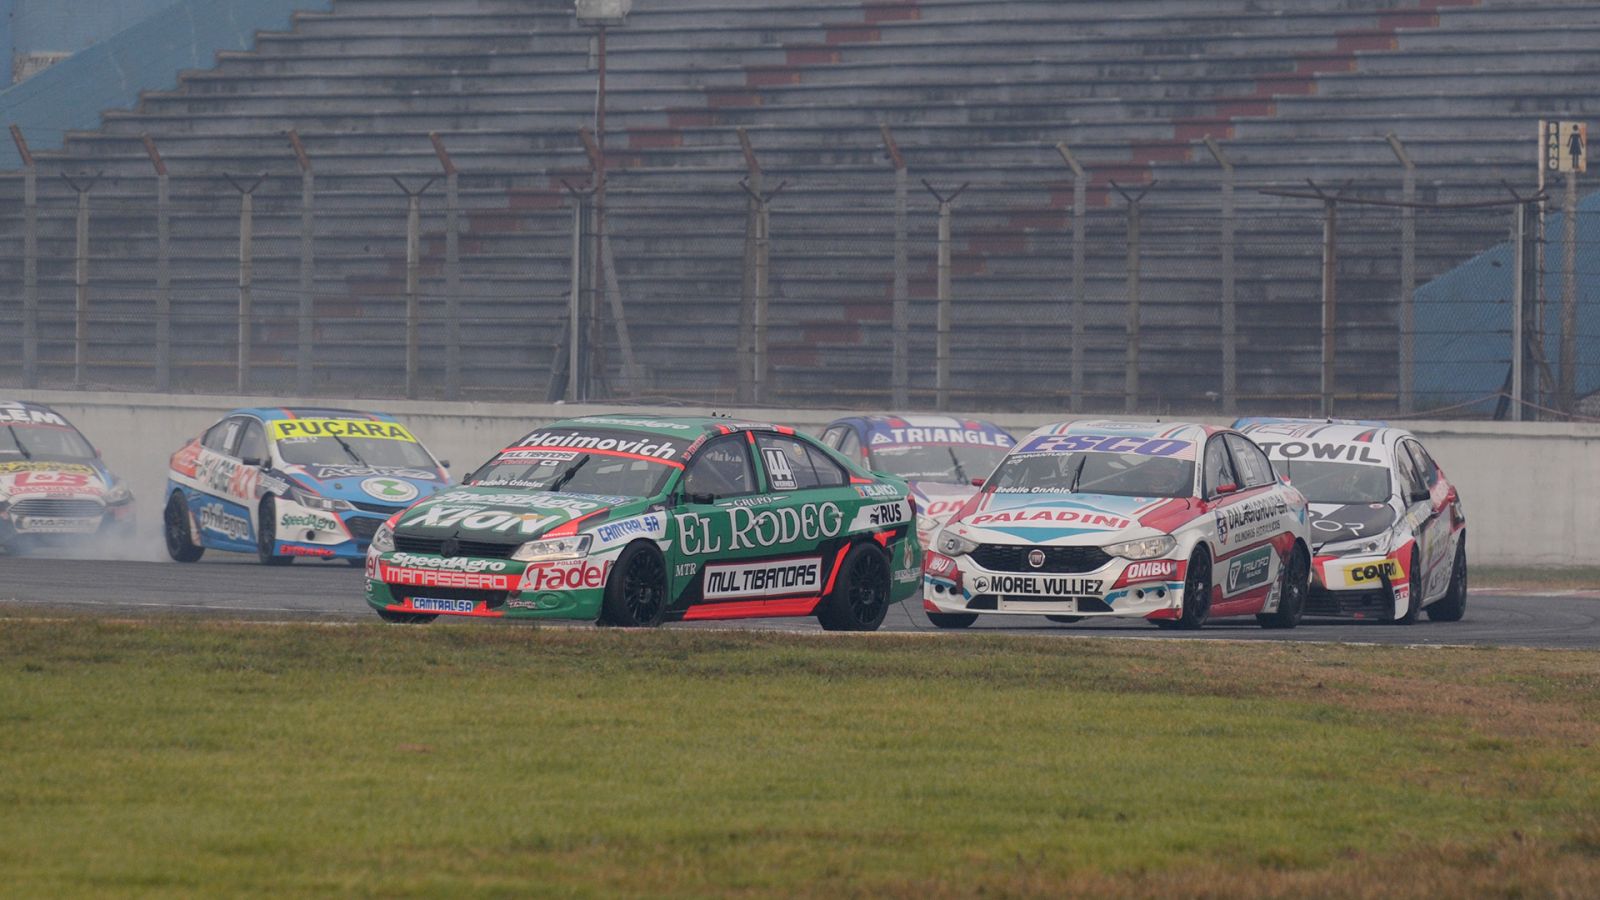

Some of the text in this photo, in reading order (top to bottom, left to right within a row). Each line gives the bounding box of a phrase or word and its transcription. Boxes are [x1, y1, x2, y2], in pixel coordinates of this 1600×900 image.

[519, 432, 676, 459] Haimovich
[891, 428, 1010, 448] TRIANGLE
[1019, 435, 1193, 456] ESCO
[766, 450, 793, 480] 44
[734, 497, 773, 507] GRUPO
[281, 513, 336, 531] SpeedAgro
[880, 504, 902, 523] RUS
[971, 510, 1131, 529] PALADINI
[675, 512, 721, 556] EL
[391, 552, 506, 573] SpeedAgro
[675, 563, 698, 577] MTR
[1127, 562, 1171, 579] OMBU
[386, 567, 507, 589] MANASSERO
[526, 559, 609, 591] Fadel
[706, 563, 818, 593] MULTIBANDAS
[991, 576, 1041, 594] MOREL
[1043, 577, 1104, 596] VULLIEZ
